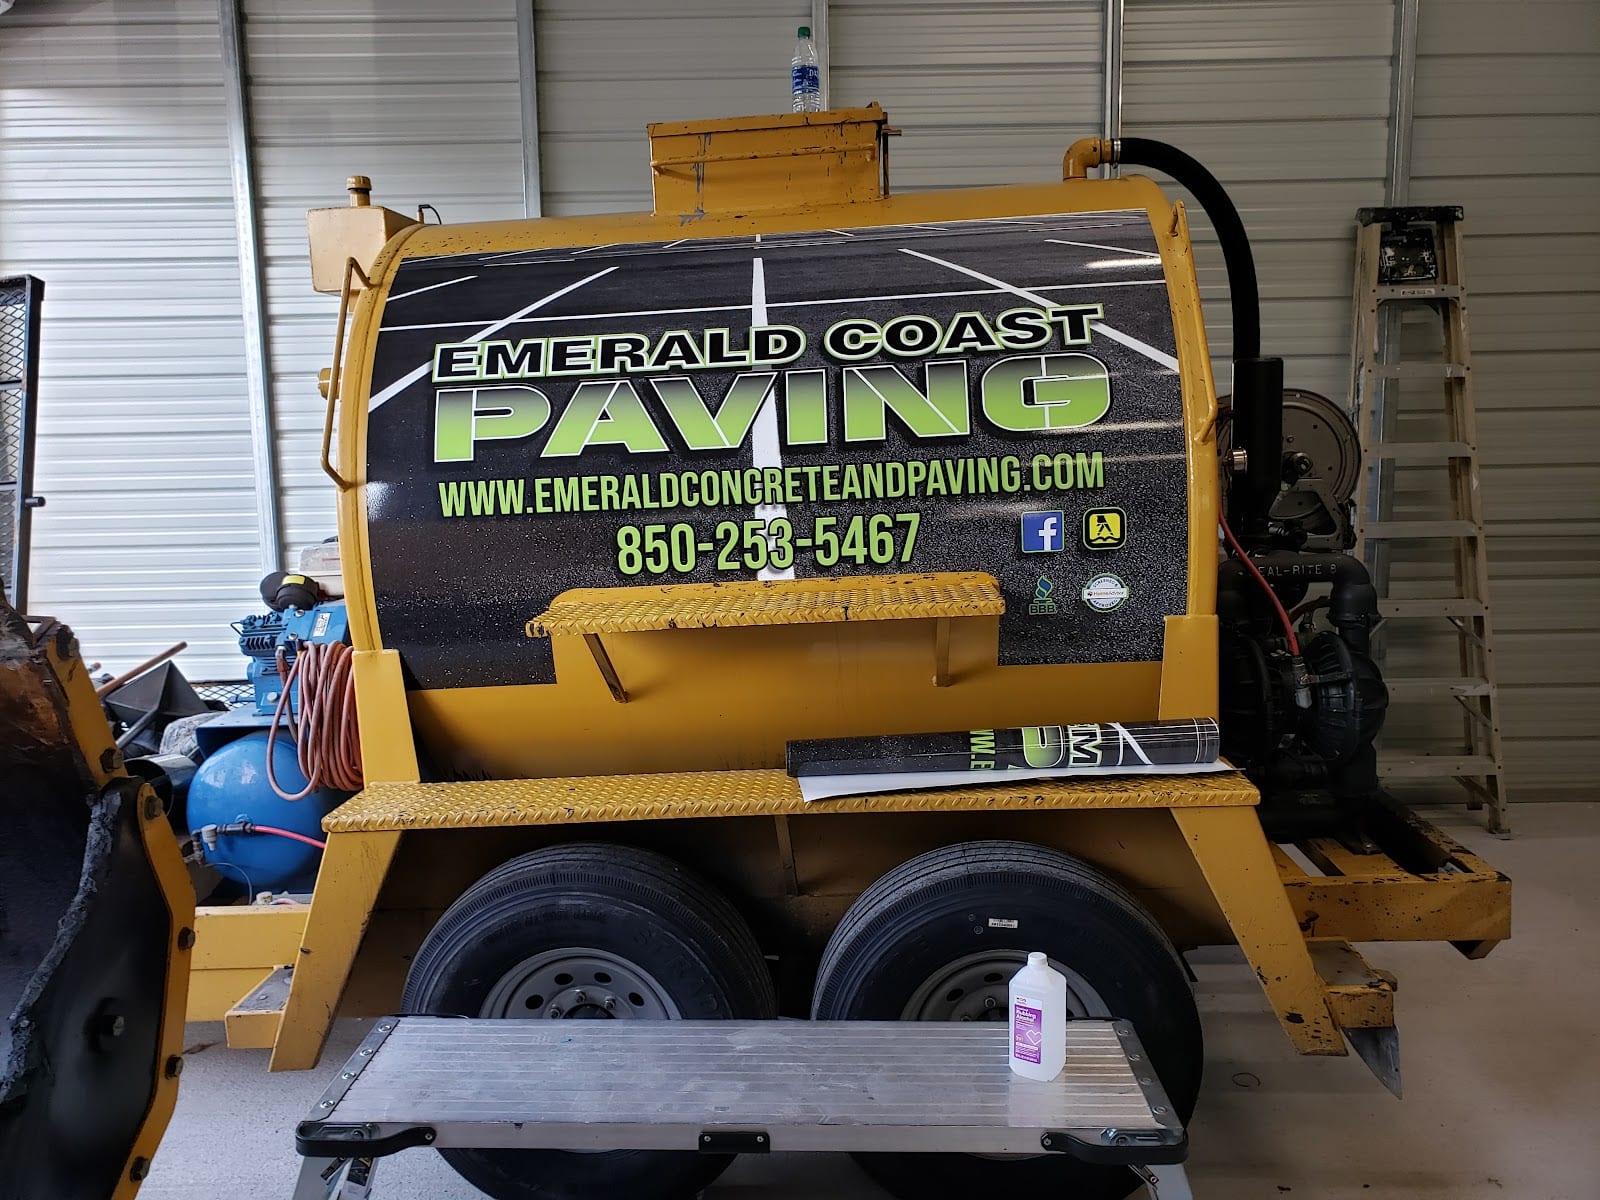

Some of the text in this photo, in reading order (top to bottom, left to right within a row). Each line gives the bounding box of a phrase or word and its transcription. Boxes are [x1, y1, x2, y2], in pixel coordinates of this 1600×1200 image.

[432, 303, 1104, 382] EMERALD COAST
[434, 352, 1110, 462] PAVING
[438, 452, 1105, 517] WWW.EMERALDCONCRETEANDPAVING.COM
[616, 512, 921, 575] 850-253-5467
[1256, 564, 1322, 577] EAL-RITE
[1029, 604, 1057, 615] BBB
[1067, 723, 1102, 768] M
